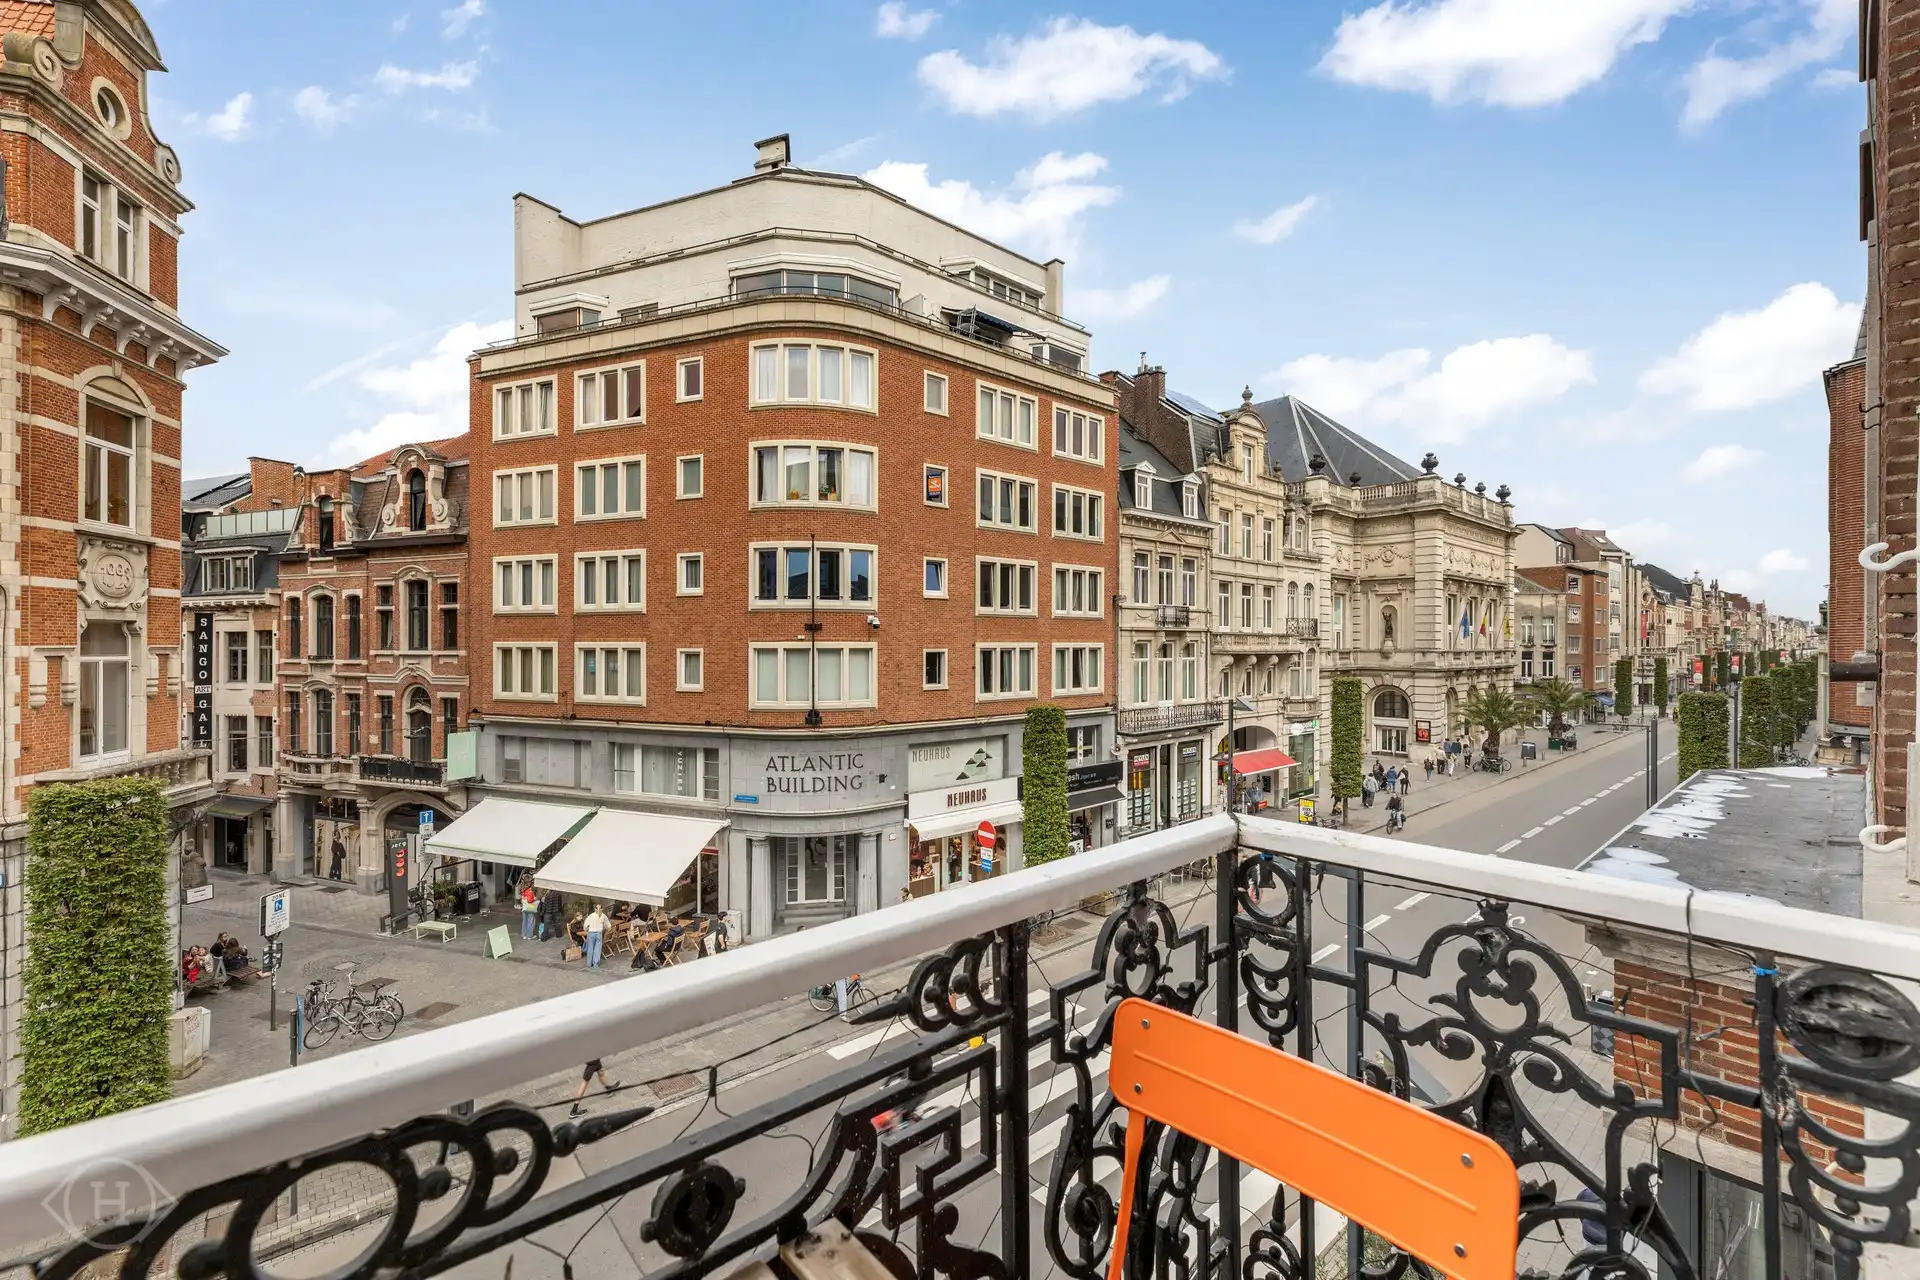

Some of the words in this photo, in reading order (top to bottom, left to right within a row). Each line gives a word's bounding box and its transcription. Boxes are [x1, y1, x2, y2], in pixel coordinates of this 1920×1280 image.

[199, 618, 208, 679] SANGO
[765, 753, 864, 772] ATLANTIC
[912, 746, 951, 762] NEUHAUS
[766, 775, 863, 793] BUILDING
[947, 788, 987, 807] NEUHAUS
[272, 892, 286, 902] ZONE
